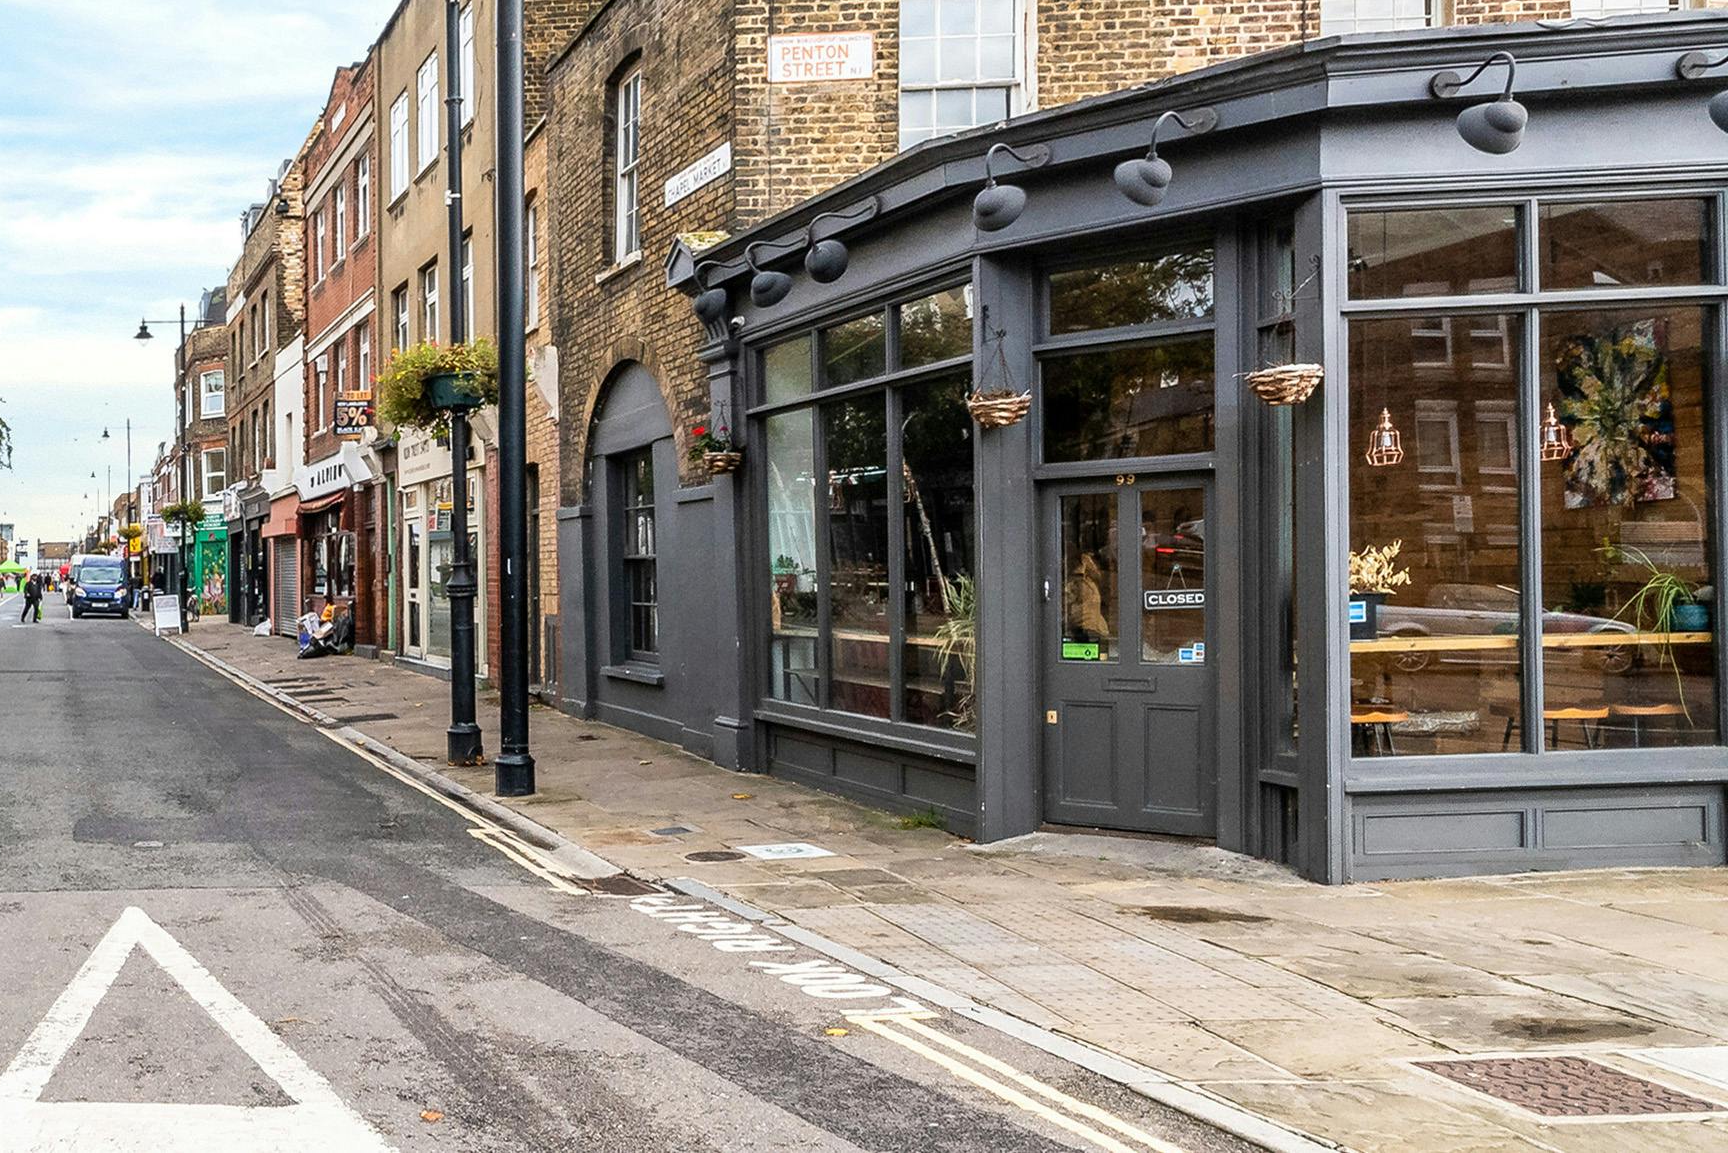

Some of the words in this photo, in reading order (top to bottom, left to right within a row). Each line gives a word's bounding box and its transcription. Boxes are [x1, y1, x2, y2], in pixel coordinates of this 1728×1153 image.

[781, 44, 849, 61] PENTON
[782, 61, 846, 78] STREET
[667, 179, 691, 202] CHAPEL
[693, 157, 721, 184] MARKET
[336, 407, 368, 427] 5%
[1115, 474, 1136, 486] 99
[1148, 593, 1205, 605] CLOSED
[747, 959, 930, 1018] LOOK
